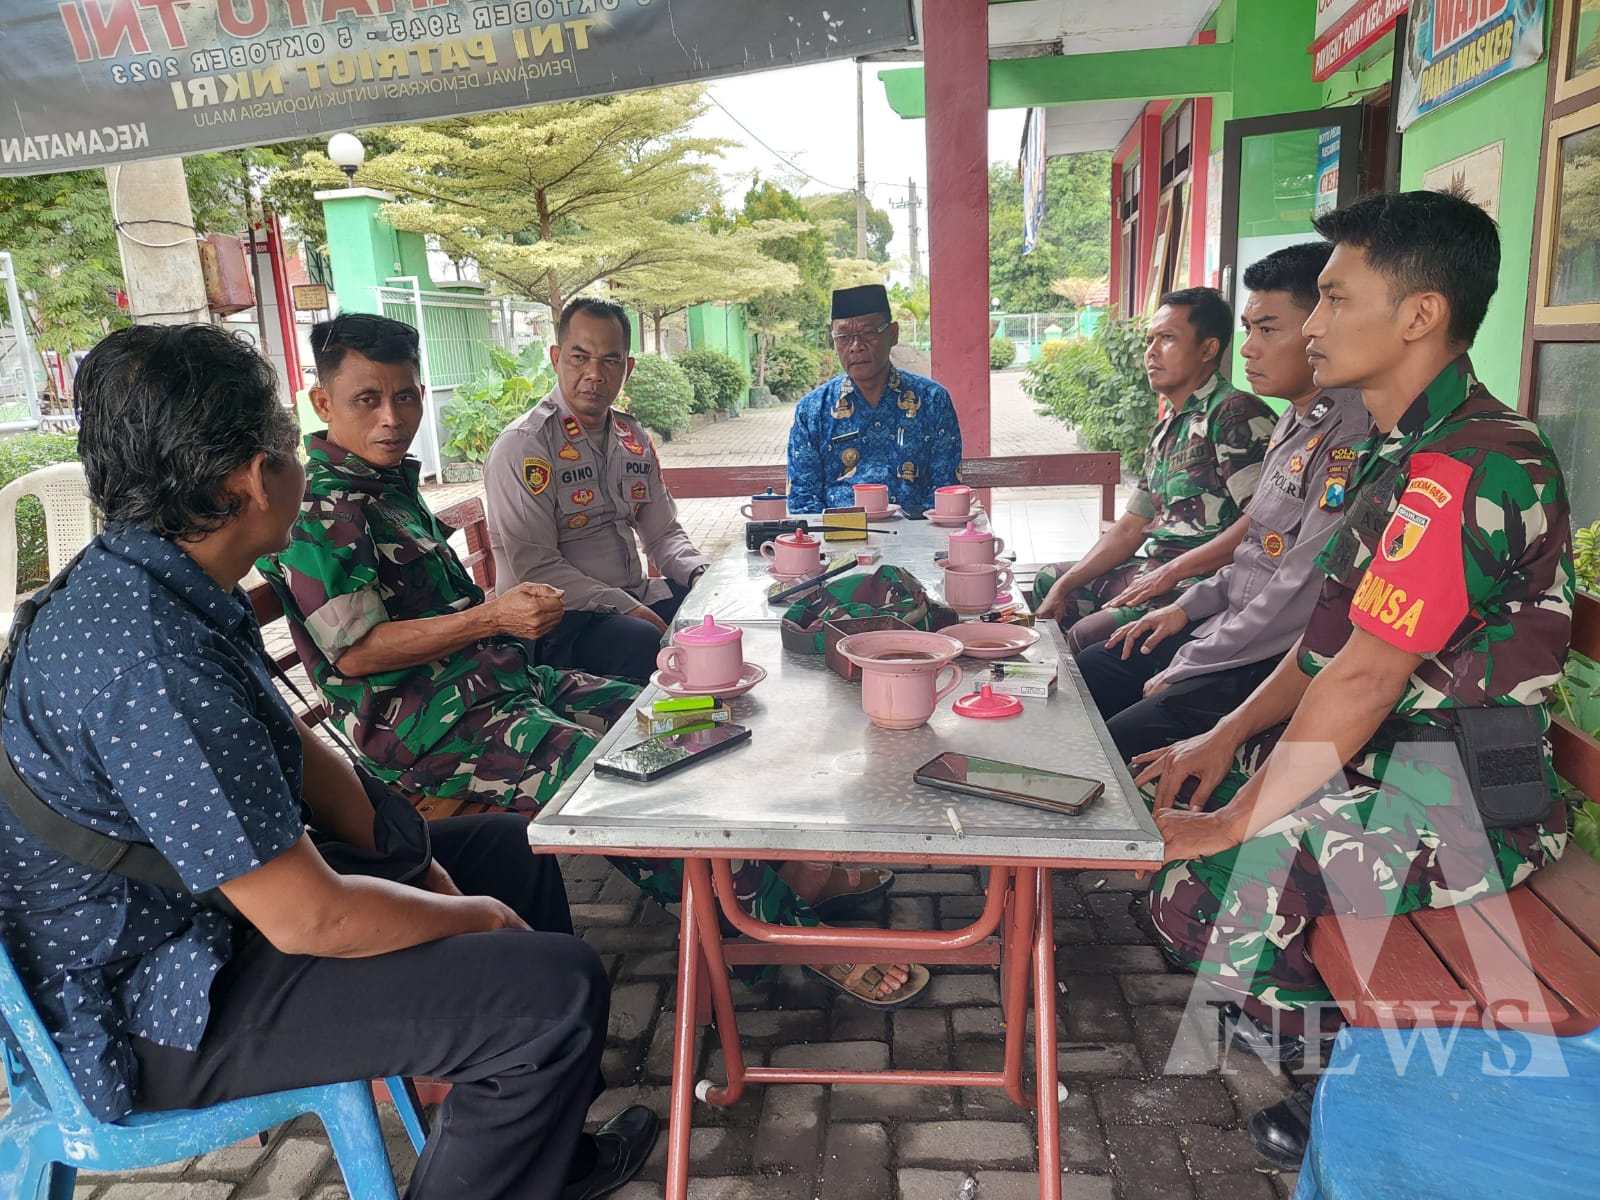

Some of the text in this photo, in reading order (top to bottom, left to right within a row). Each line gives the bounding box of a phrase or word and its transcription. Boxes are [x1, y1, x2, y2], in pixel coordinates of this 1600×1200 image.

[1343, 12, 1367, 53] POINT
[1434, 0, 1507, 54] WAJ
[1421, 18, 1515, 104] PAKAI MASKER
[562, 466, 593, 484] GINO
[626, 462, 651, 474] POLR
[1271, 470, 1297, 497] POLR
[1352, 571, 1425, 638] BINSA
